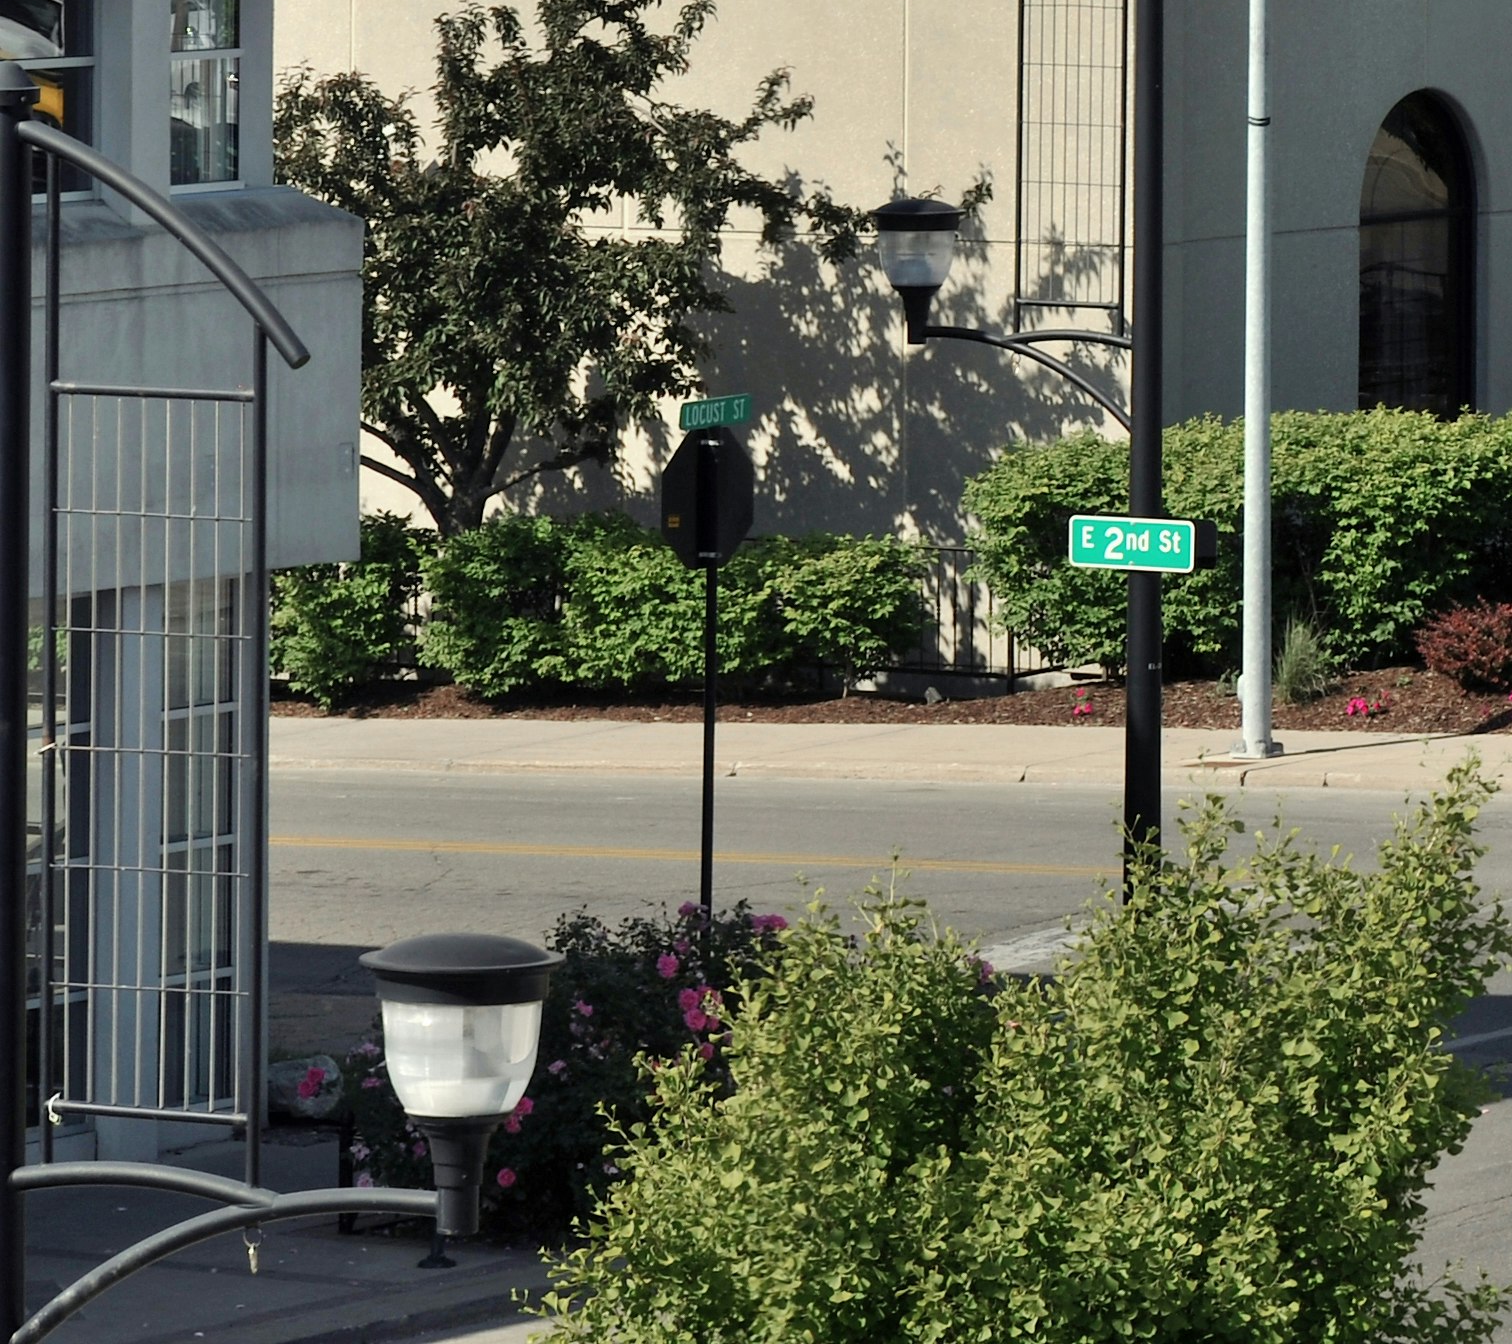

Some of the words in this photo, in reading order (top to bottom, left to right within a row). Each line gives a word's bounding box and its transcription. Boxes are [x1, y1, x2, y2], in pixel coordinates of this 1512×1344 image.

[685, 401, 726, 426] LOCUST
[733, 398, 745, 420] ST
[1082, 525, 1095, 549] E
[1104, 527, 1150, 560] 2nd
[1159, 529, 1182, 554] St
